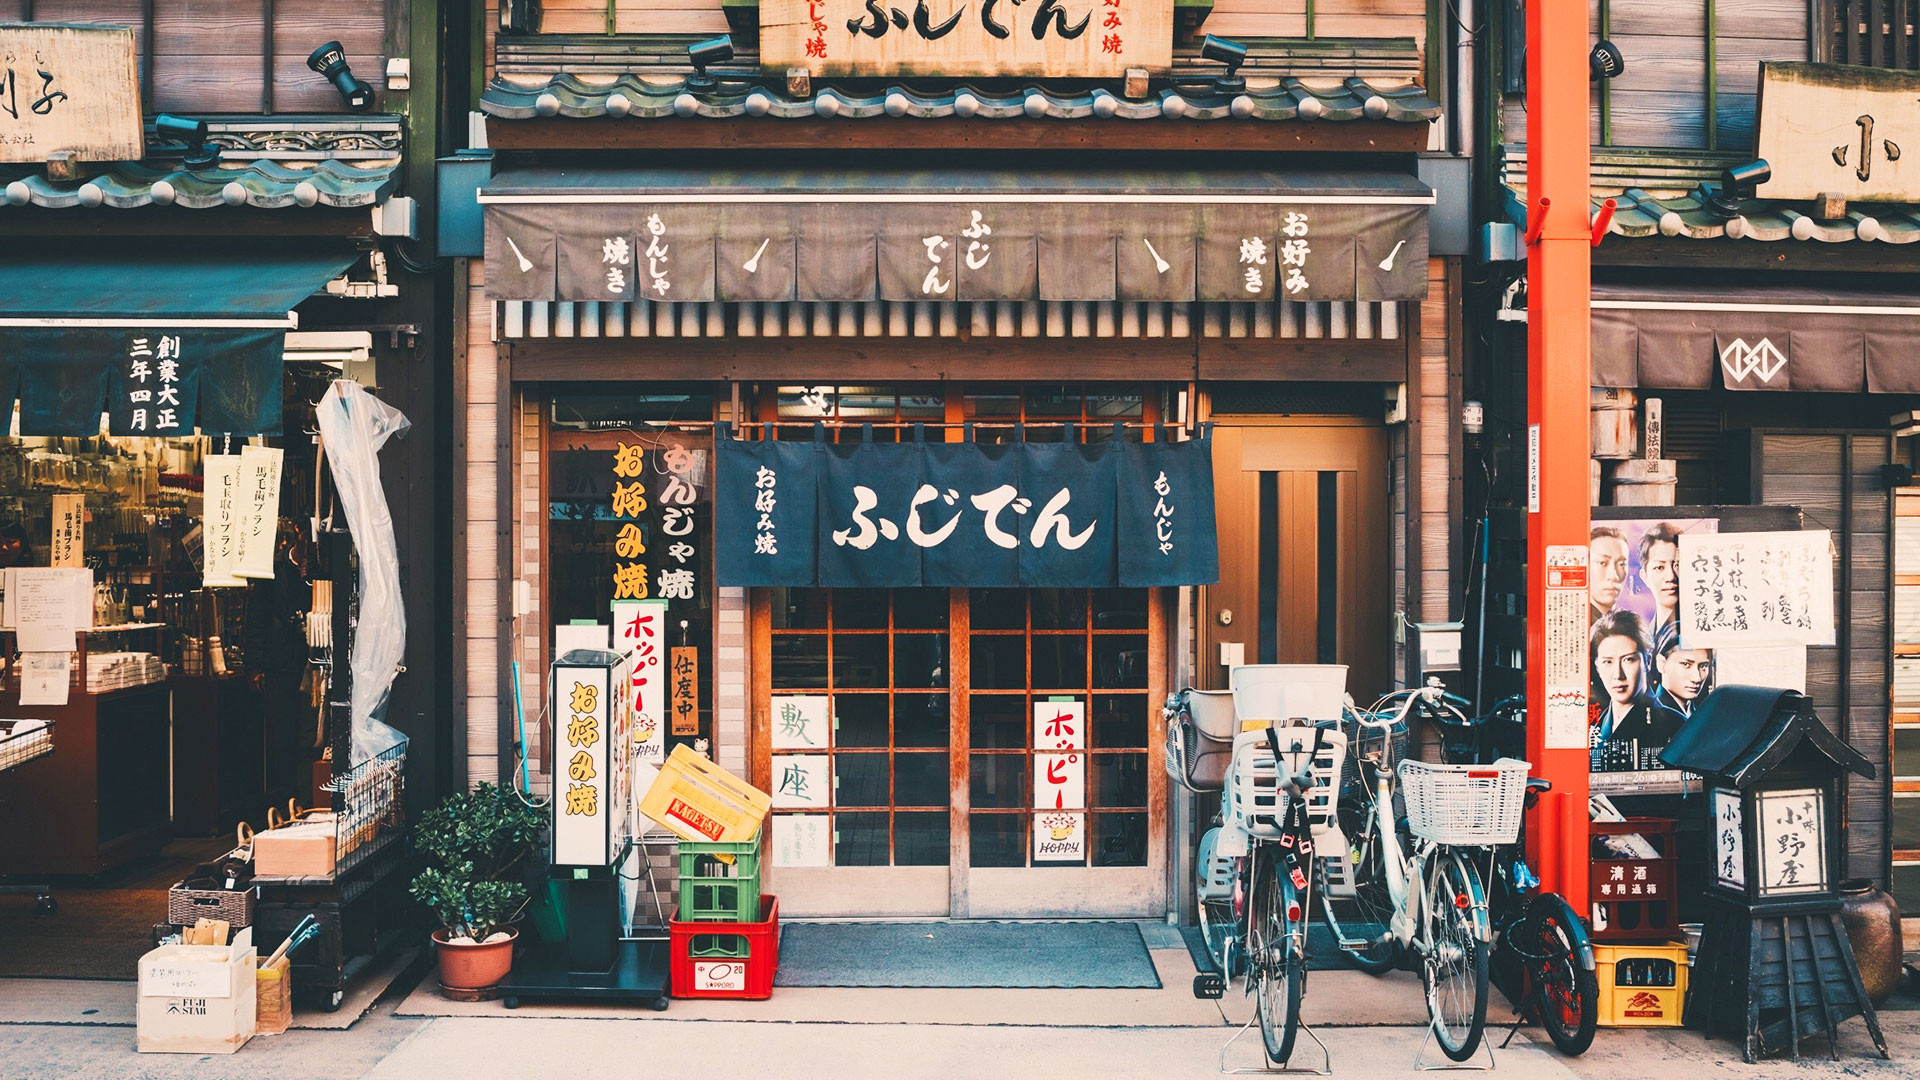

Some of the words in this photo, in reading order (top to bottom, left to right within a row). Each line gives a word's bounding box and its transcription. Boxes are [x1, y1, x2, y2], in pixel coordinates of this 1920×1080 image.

[805, 0, 827, 58] じゃ焼
[1832, 114, 1901, 182] 小
[602, 237, 630, 293] 焼き
[646, 213, 671, 296] もんじゃ
[922, 235, 951, 294] でん
[962, 209, 992, 270] ふじ
[1240, 237, 1267, 294] 焼き
[1281, 212, 1311, 294] お好み
[129, 338, 152, 431] 三年四月
[156, 335, 180, 429] 創業大正
[220, 474, 231, 557] 毛玉取りブラシ
[253, 466, 267, 537] 馬毛歯ブラシ
[612, 441, 649, 600] お好み焼
[657, 443, 696, 600] もんじゃ焼
[754, 465, 778, 556] お好み焼
[833, 483, 1097, 550] ふじでん
[1153, 470, 1176, 556] もんじゃ
[624, 609, 658, 712] ホッピー
[674, 654, 695, 720] 仕度中
[566, 681, 599, 817] お好み焼
[779, 702, 814, 745] 敷
[779, 763, 812, 801] 座
[1045, 708, 1078, 810] ホッピー
[671, 800, 722, 836] KAGETSU
[1776, 806, 1806, 886] 小野屋
[1610, 865, 1647, 880] 清酒
[734, 965, 743, 974] 20
[182, 1007, 206, 1015] STAR
